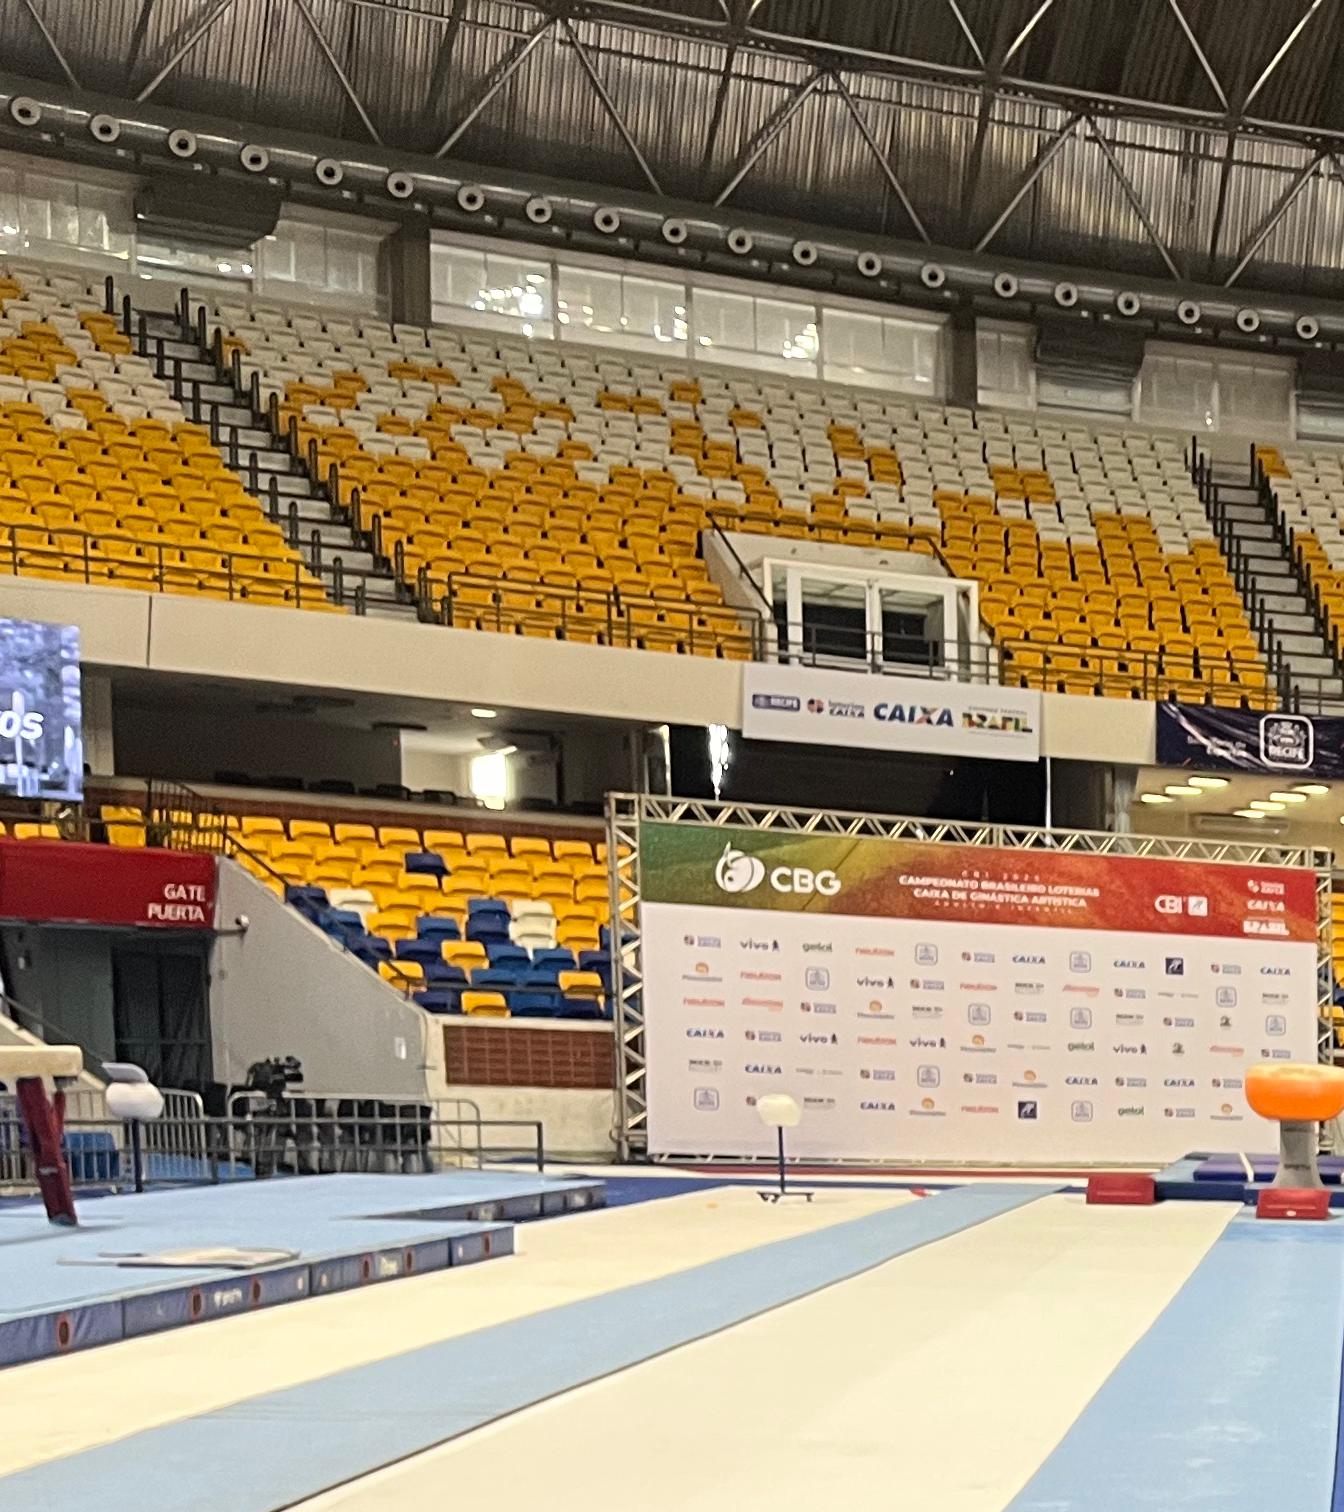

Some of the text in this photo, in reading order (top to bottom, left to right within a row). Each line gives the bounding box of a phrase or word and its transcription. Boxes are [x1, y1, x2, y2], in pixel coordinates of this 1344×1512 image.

[873, 702, 954, 727] CAIXA
[770, 866, 841, 896] CBG
[899, 875, 979, 889] CAMPEONATO
[164, 884, 206, 902] GATE
[147, 903, 206, 922] PUERTA
